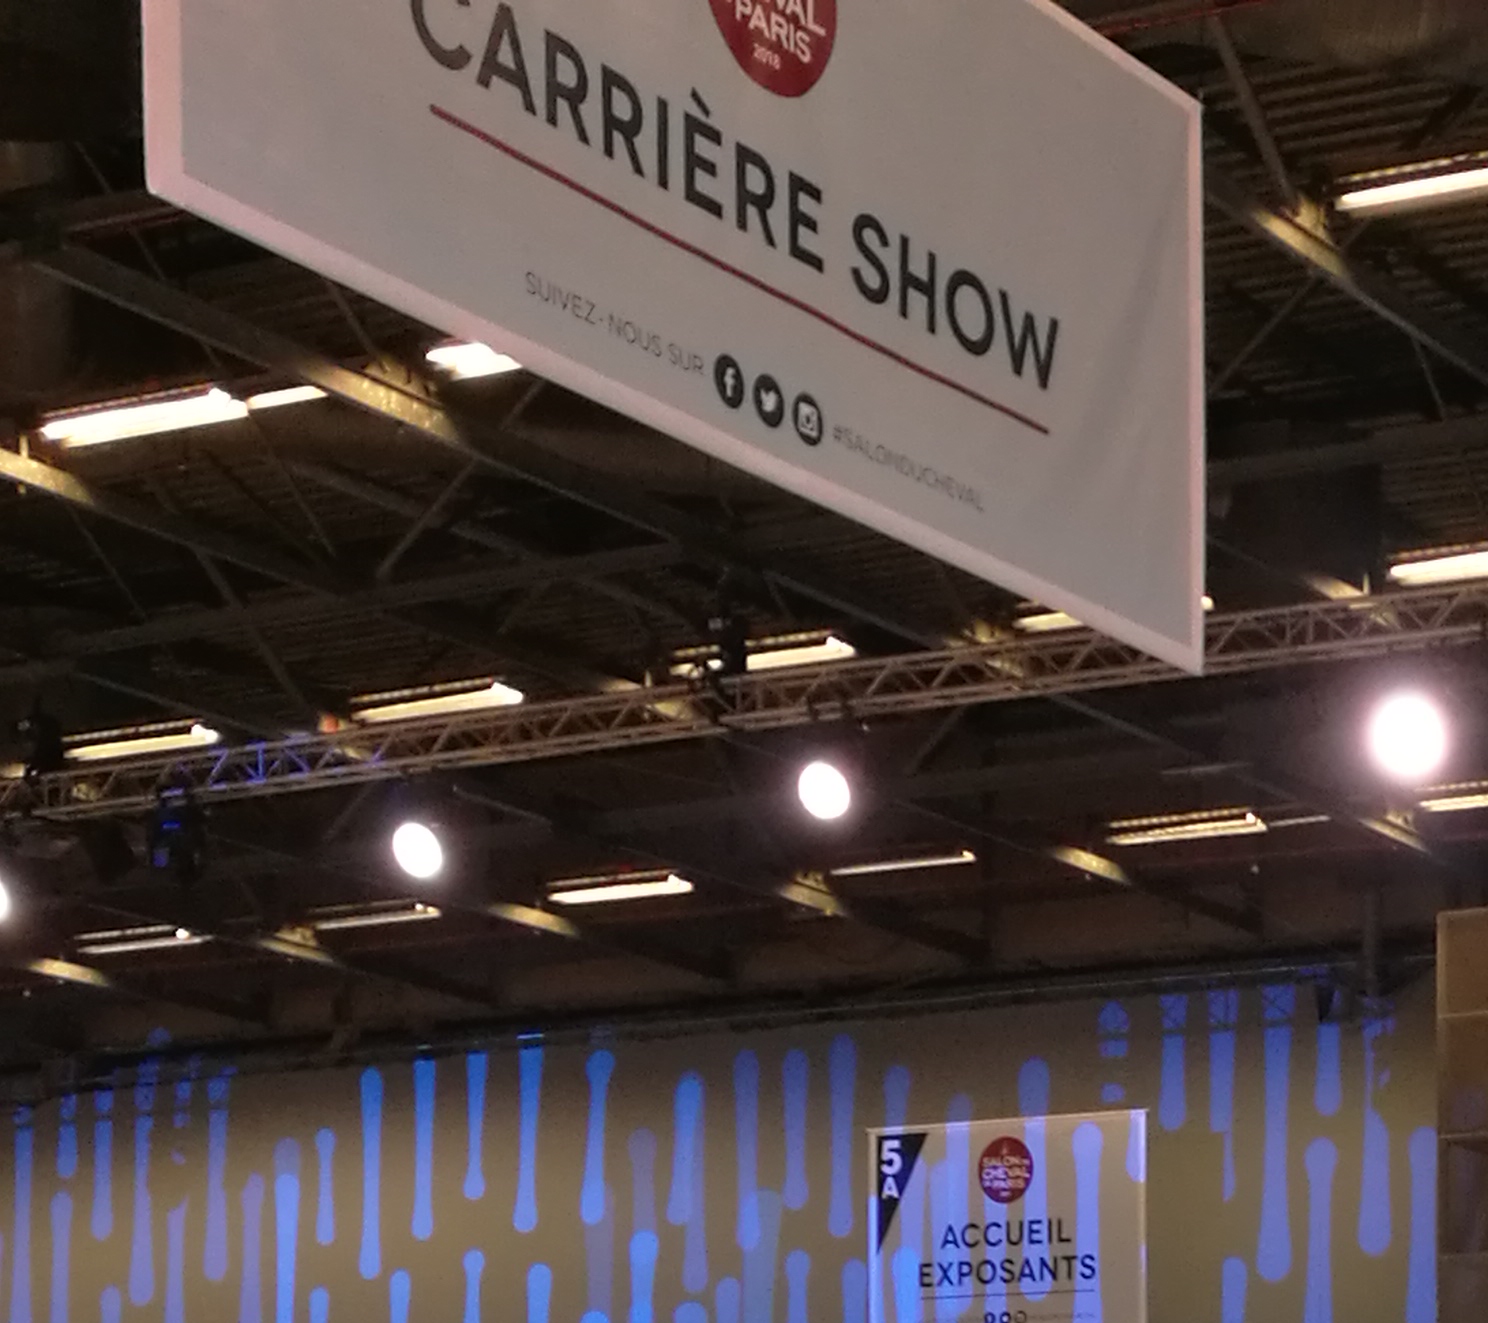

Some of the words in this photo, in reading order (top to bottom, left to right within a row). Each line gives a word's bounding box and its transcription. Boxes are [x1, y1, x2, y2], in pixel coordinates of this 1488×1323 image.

[735, 0, 812, 63] PARIS
[410, 0, 824, 274] CARRIÈRE
[850, 213, 1060, 391] SHOW
[668, 343, 704, 376] SUR
[880, 1140, 902, 1175] 5
[881, 1177, 899, 1199] A
[941, 1217, 1072, 1250] ACCUEIL
[918, 1254, 1097, 1288] EXPOSANTS
